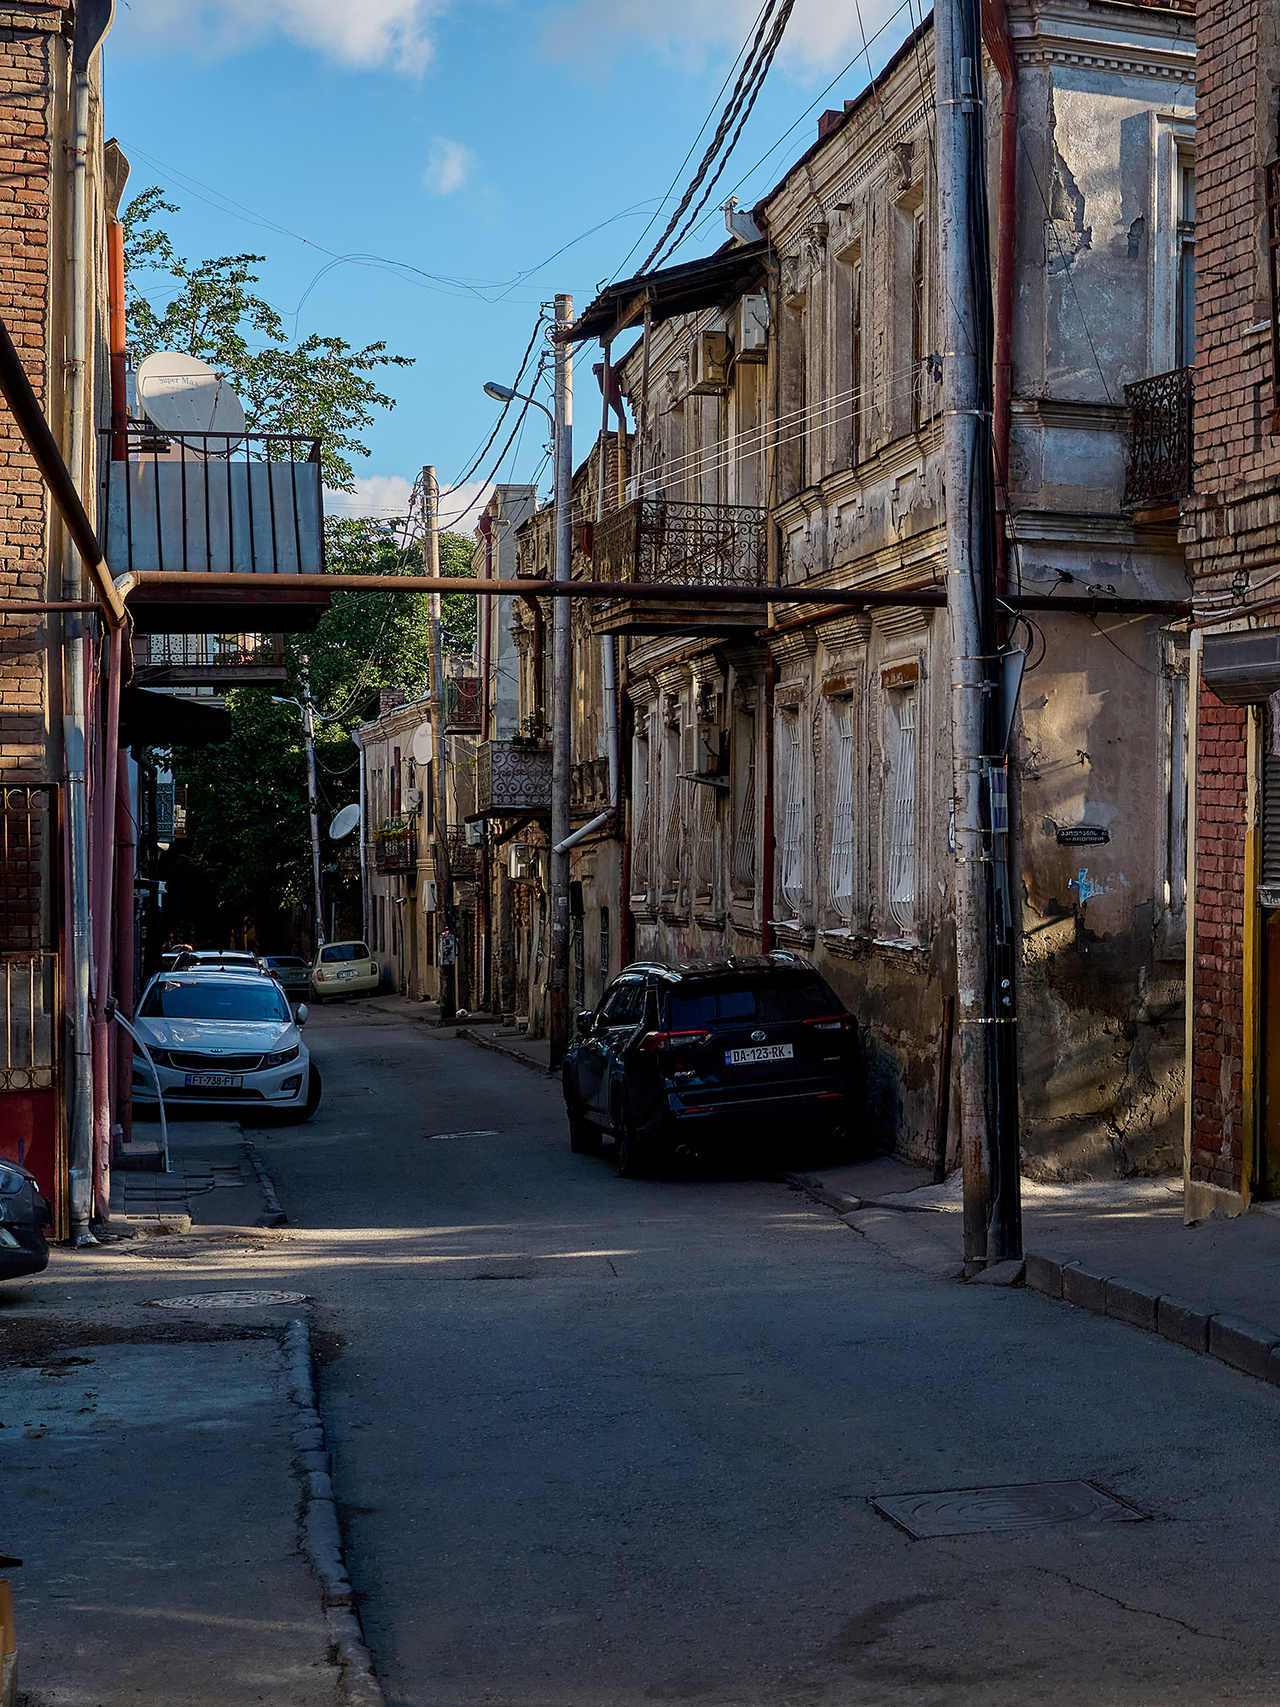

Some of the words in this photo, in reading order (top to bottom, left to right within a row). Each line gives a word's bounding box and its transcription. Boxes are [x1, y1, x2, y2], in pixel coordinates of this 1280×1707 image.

[157, 376, 179, 385] Super
[181, 377, 200, 387] Max
[732, 1045, 785, 1062] DA-123-RK
[192, 1076, 236, 1086] FT-738-FT
